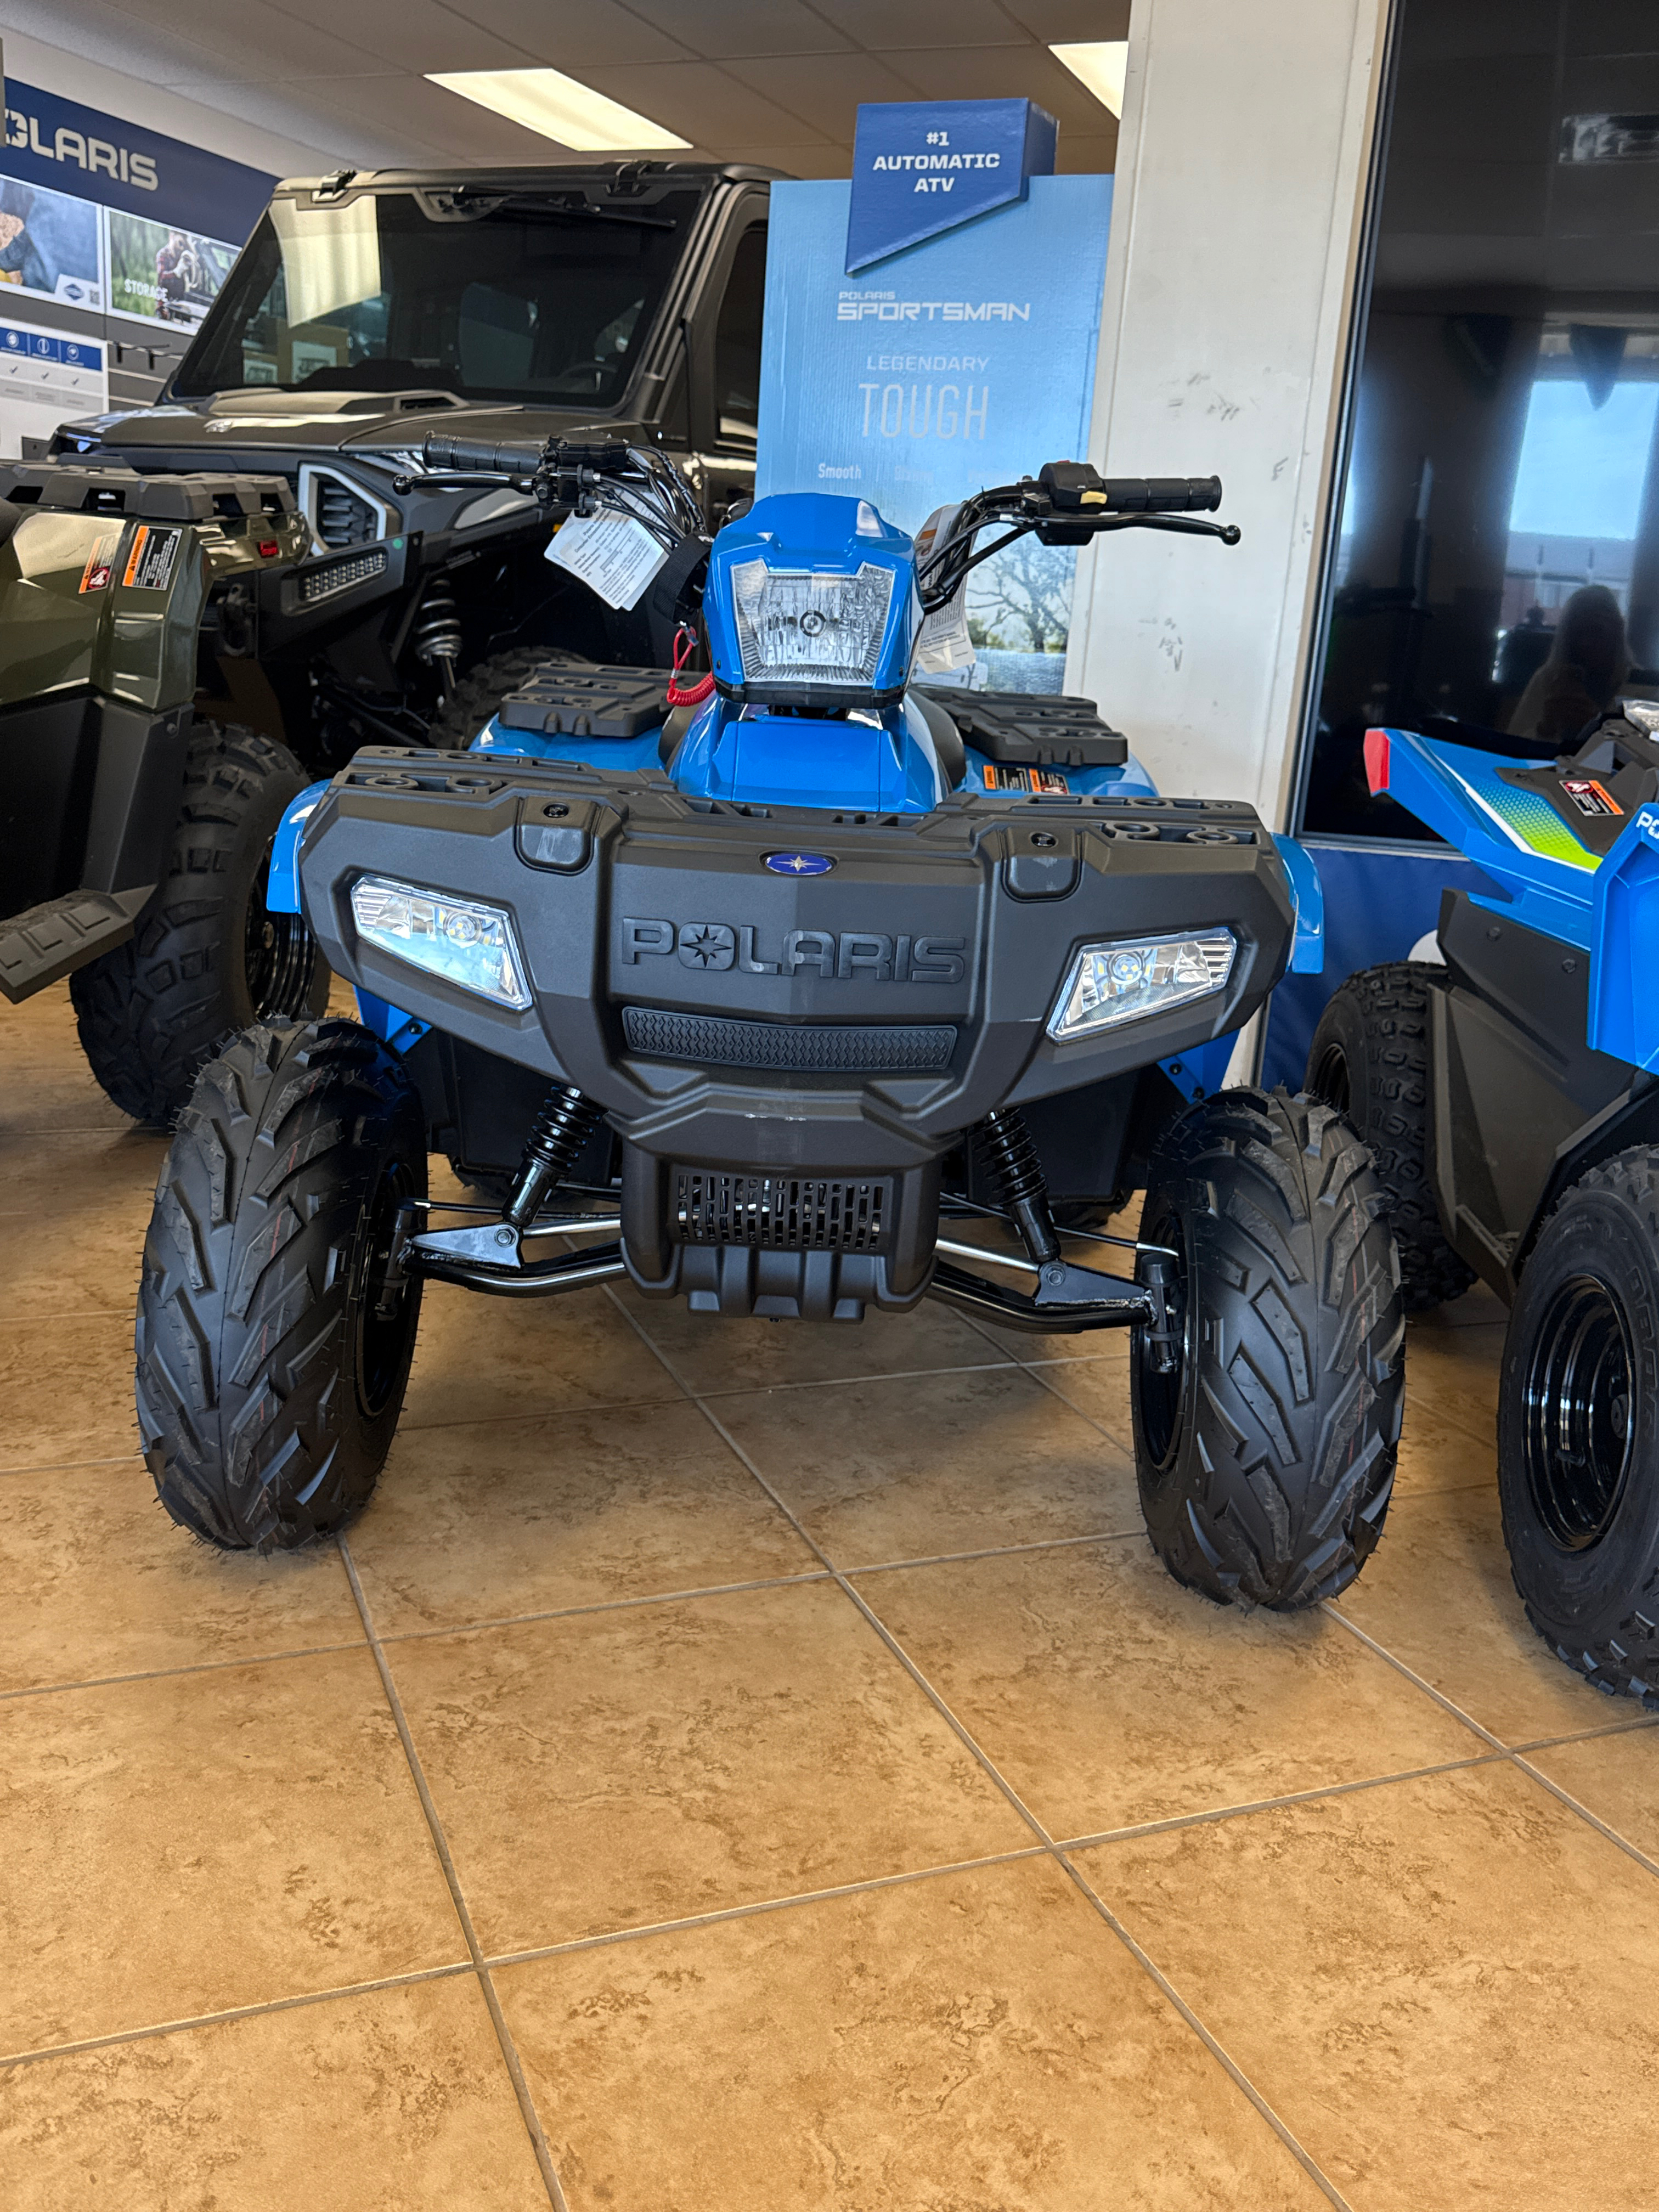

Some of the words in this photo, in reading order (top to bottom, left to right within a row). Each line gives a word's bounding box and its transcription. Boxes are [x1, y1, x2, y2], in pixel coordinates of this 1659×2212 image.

[926, 132, 950, 146] #1
[5, 108, 158, 191] OLARIS
[872, 153, 1000, 171] AUTOMATIC
[913, 177, 955, 192] ATV
[124, 278, 168, 302] STORAGE
[839, 291, 895, 300] POLARIS
[837, 302, 1030, 321] SPORTSMAN
[866, 356, 989, 371] LEGENDARY
[859, 383, 989, 440] TOUGH
[818, 463, 861, 480] Smooth
[621, 916, 966, 984] POLARIS
